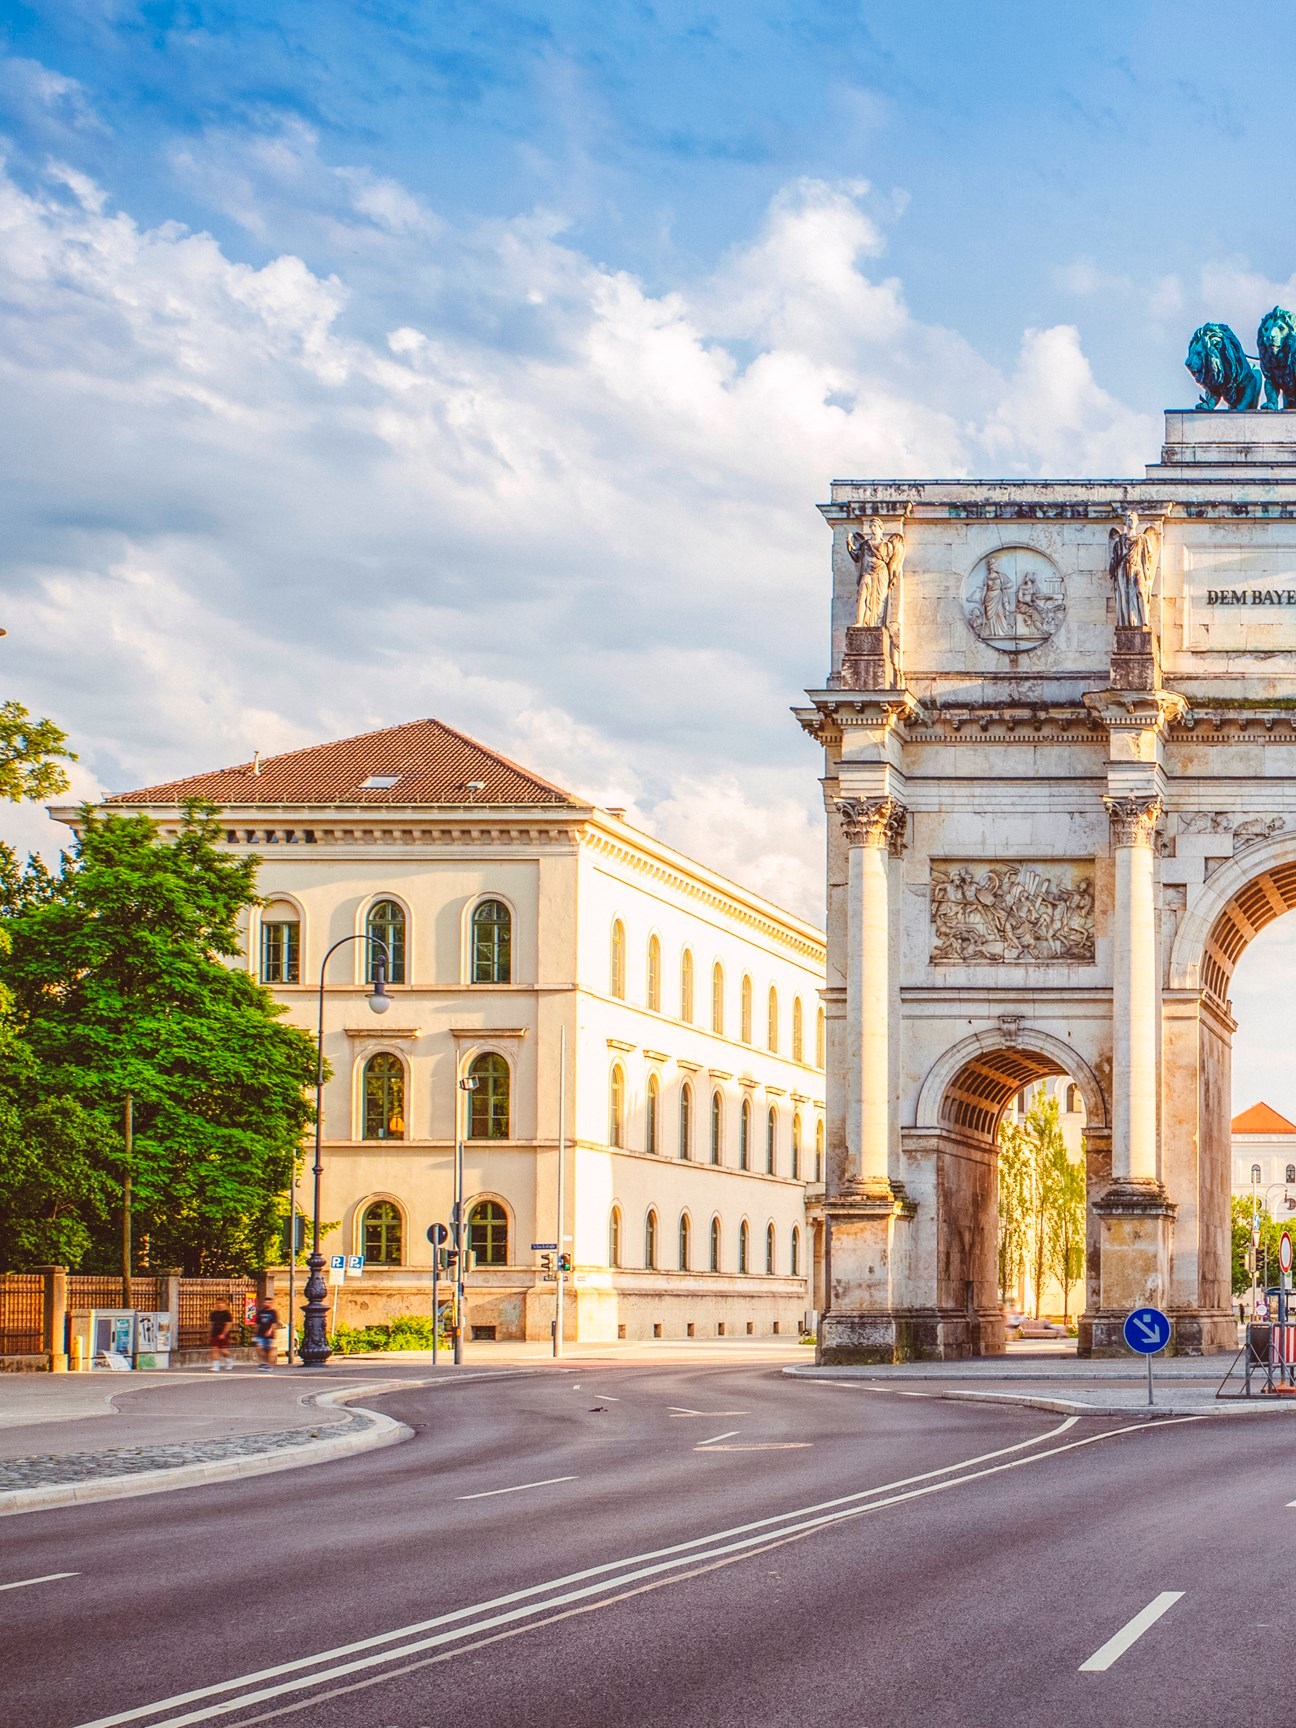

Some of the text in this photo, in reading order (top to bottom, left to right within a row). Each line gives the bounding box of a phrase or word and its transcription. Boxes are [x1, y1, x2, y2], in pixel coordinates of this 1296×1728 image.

[1206, 590, 1248, 605] DEM
[332, 1257, 341, 1267] P
[350, 1257, 359, 1267] P
